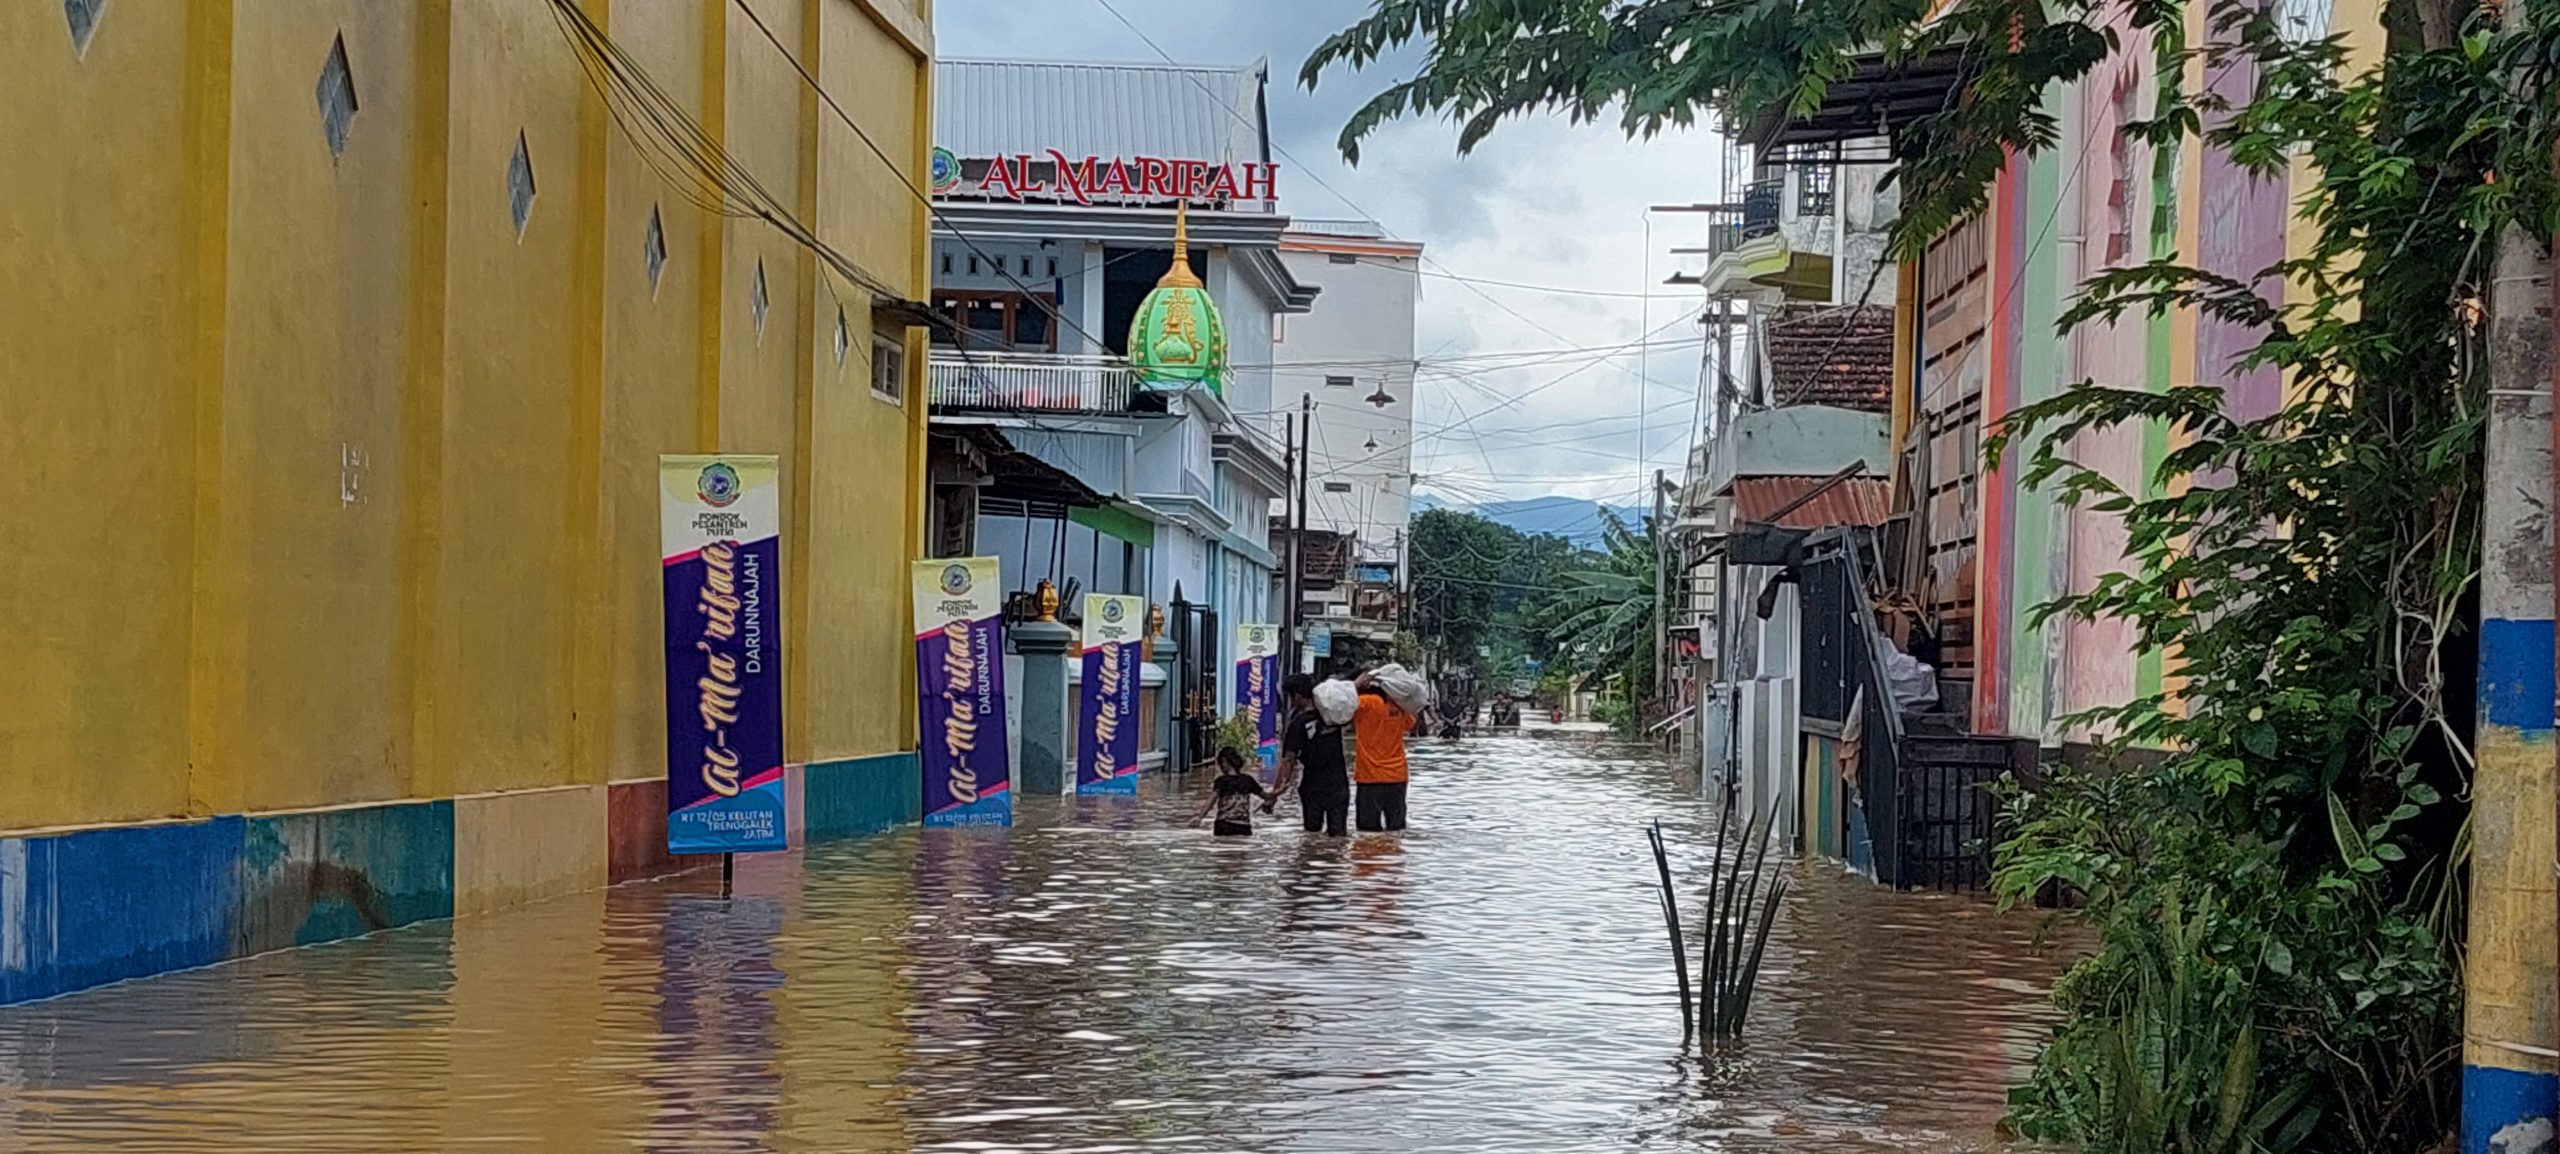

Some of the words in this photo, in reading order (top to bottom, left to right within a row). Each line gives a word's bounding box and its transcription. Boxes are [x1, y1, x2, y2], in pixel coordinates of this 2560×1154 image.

[978, 152, 1044, 200] AL
[692, 520, 748, 529] PESANTREN
[745, 553, 760, 674] DARUNNAJAH
[976, 626, 992, 715] DARUNNAJAH
